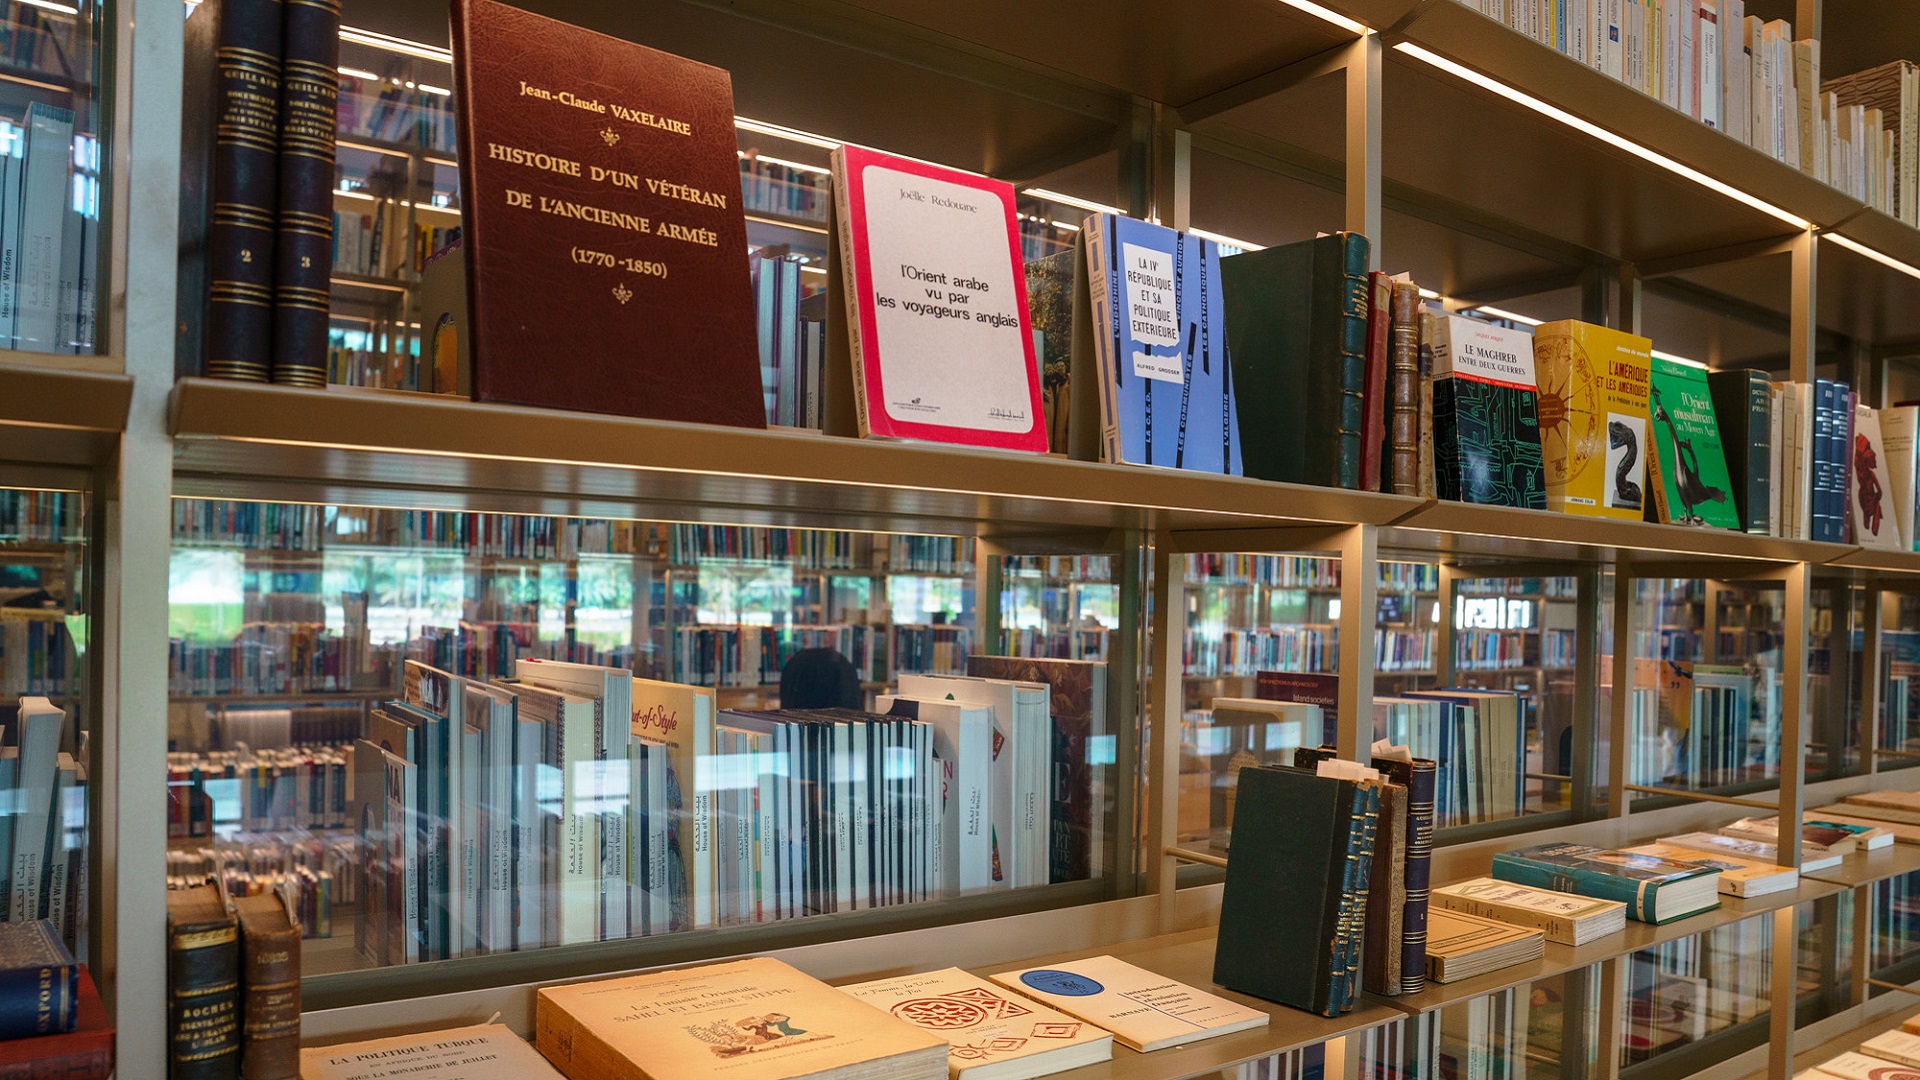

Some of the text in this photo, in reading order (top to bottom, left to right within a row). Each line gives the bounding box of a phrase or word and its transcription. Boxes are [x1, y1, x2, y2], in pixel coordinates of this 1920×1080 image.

[519, 81, 691, 136] Jean-Claude VAXELAIRE
[488, 142, 727, 209] HISTOIRE D'UN VÉTÉRAN
[900, 188, 978, 214] Joëlle Redouane
[505, 189, 718, 247] DE L'ANCIENNE ARMÉE
[3, 249, 12, 281] Wisdom
[241, 249, 252, 263] 2
[301, 256, 311, 268] 3
[1138, 257, 1148, 270] LA
[5, 282, 10, 291] of
[901, 264, 989, 292] l'Orient arabe
[1127, 270, 1173, 292] RÉPUBLIQUE
[925, 288, 970, 305] vu par
[1111, 270, 1120, 339] L'INDOCHINE
[1141, 289, 1162, 305] ET SA
[1200, 258, 1209, 353] LES CATHOLIQUES
[876, 292, 1019, 329] les voyageurs anglais
[1133, 303, 1172, 323] POLITIQUE
[1465, 344, 1475, 355] LE
[1476, 346, 1518, 364] MAGHREB
[1136, 363, 1181, 376] ALFRED GROSSER
[1458, 355, 1526, 376] ENTRE DEUX GUERRES
[1608, 360, 1649, 384] L'AMÉRIQUE
[1596, 375, 1604, 388] ET
[1605, 378, 1617, 391] LES
[1178, 354, 1194, 452] LES COMMUNISTES
[1681, 391, 1711, 411] l'Orient
[1673, 407, 1715, 425] musulman
[1145, 429, 1152, 444] LA
[1676, 423, 1684, 431] au
[1684, 421, 1704, 437] Moyen
[1293, 694, 1335, 706] Island societies
[702, 822, 708, 832] of
[28, 853, 36, 886] Wisdom
[53, 863, 64, 896] Wisdom
[28, 885, 35, 897] of
[55, 895, 61, 908] of
[38, 967, 52, 1033] OXFORD
[613, 987, 799, 1023] SAHEL ET BASSE STEPPE
[631, 984, 759, 1012] La Tunisie Orientale
[1109, 1007, 1152, 1019] BARNAVE
[329, 1037, 489, 1067] LA POLITIQUE TURQUE
[385, 1056, 423, 1067] AFRIQUE
[442, 1050, 466, 1058] NORD
[389, 1062, 443, 1076] MONARCHIE
[446, 1060, 458, 1068] DE
[461, 1053, 498, 1065] JUILLET
